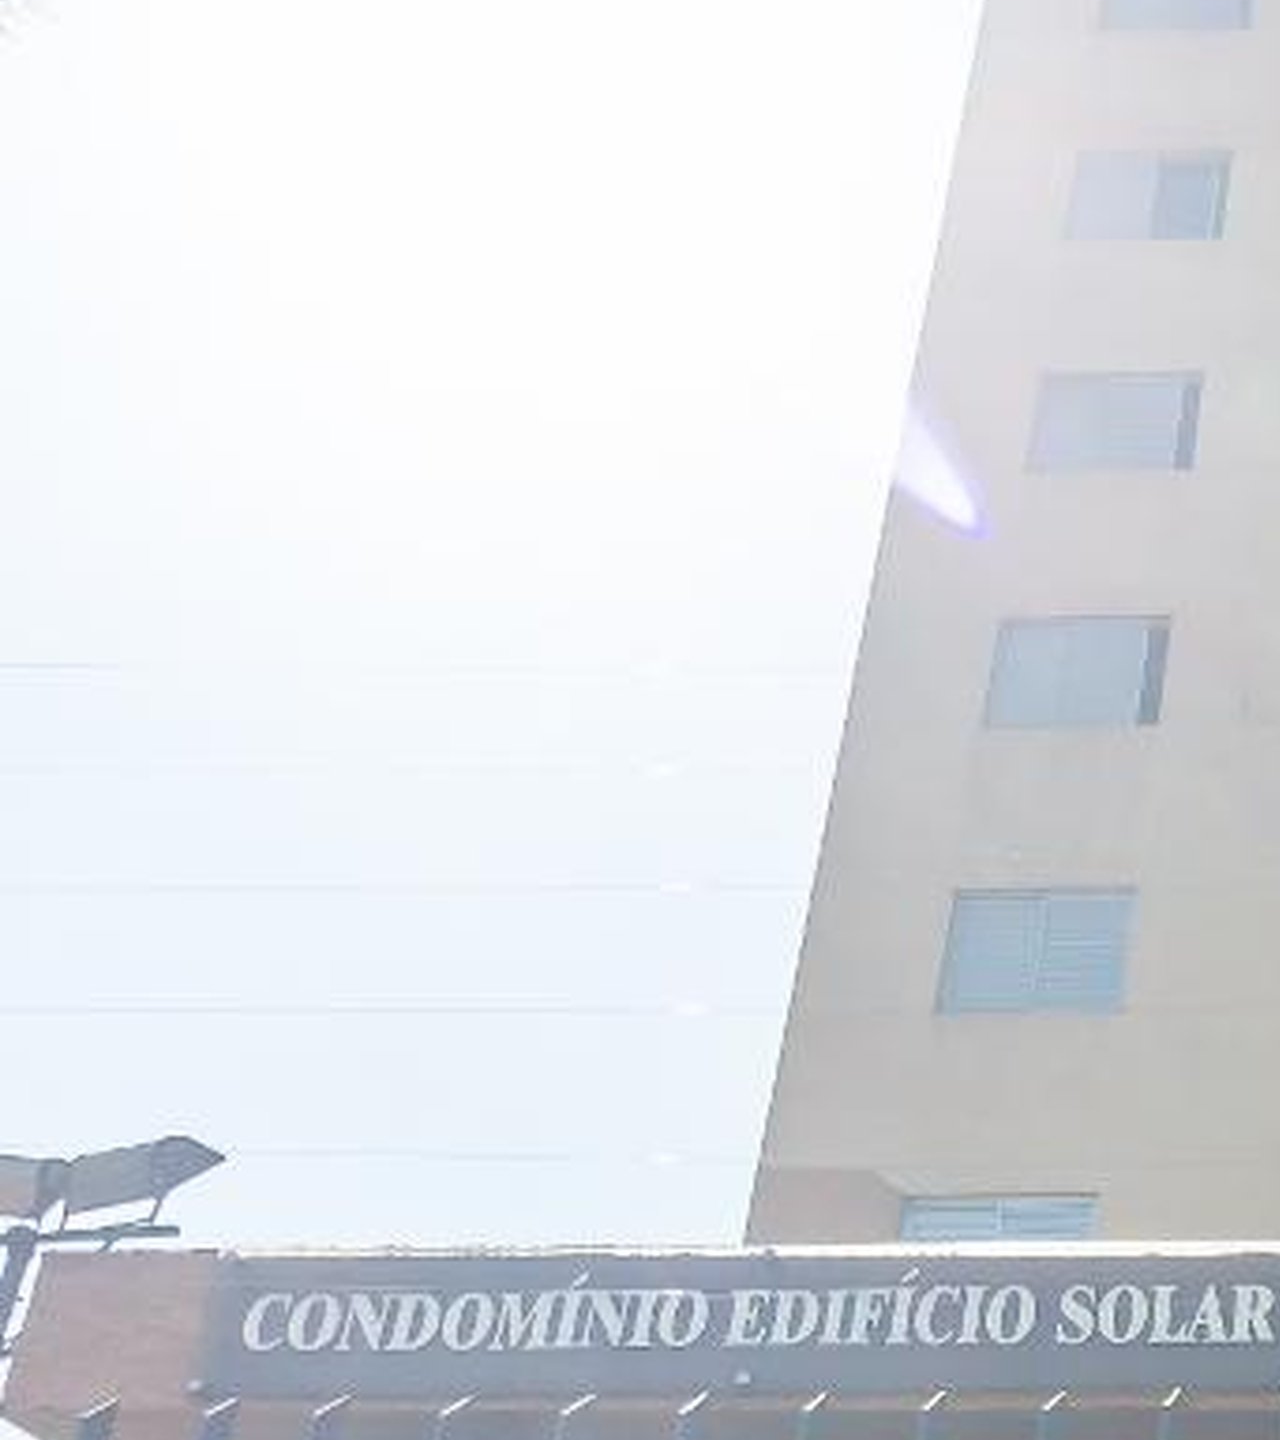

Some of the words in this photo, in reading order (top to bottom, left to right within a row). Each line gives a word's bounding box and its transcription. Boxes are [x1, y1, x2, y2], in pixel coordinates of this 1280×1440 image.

[242, 1272, 709, 1352] CONDOMÍNIO
[724, 1267, 1037, 1346] EDIFÍCIO
[1054, 1283, 1277, 1345] SOLAR
